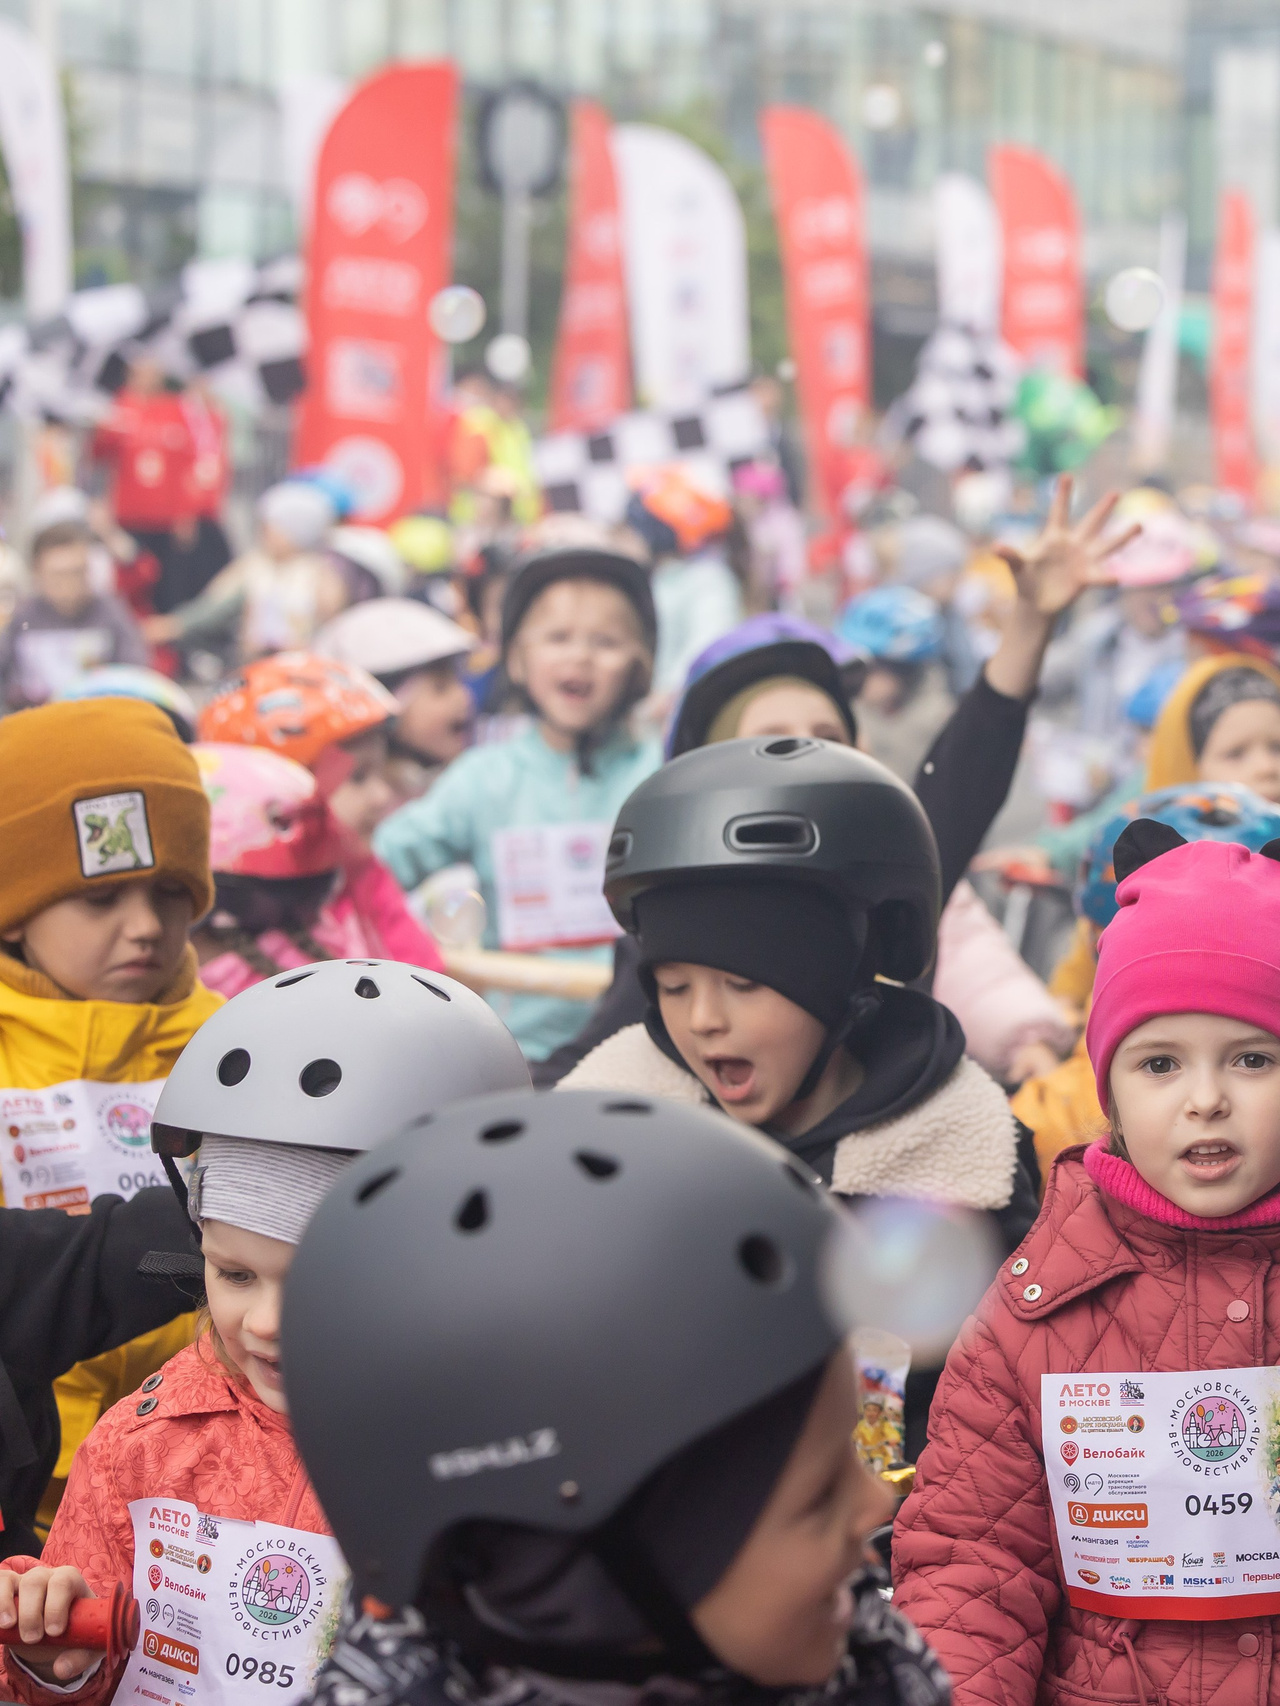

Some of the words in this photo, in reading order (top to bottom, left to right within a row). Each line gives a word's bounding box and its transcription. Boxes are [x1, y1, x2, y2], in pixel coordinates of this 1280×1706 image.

[118, 1170, 170, 1191] 006
[1060, 1383, 1110, 1397] ЛЕТО
[1170, 1382, 1258, 1420] МОСКОВСКИЙ
[1083, 1447, 1145, 1458] Велобайк
[1169, 1426, 1260, 1476] ВЕЛОФЕСТИВАЛЬ
[1206, 1450, 1224, 1458] 2026
[1185, 1493, 1253, 1516] 0459
[149, 1507, 191, 1527] ЛЕТО
[158, 1523, 190, 1538] МОСКВЕ
[1082, 1536, 1119, 1545] мангазея
[237, 1539, 327, 1586] МОСКОВСКИЙ
[1160, 1575, 1174, 1585] FM
[1242, 1572, 1280, 1583] Первые
[164, 1577, 206, 1601] Велобайк
[229, 1581, 323, 1640] ВЕЛОФЕСТИВАЛЬ
[259, 1610, 278, 1620] 2026
[226, 1653, 295, 1688] 0985
